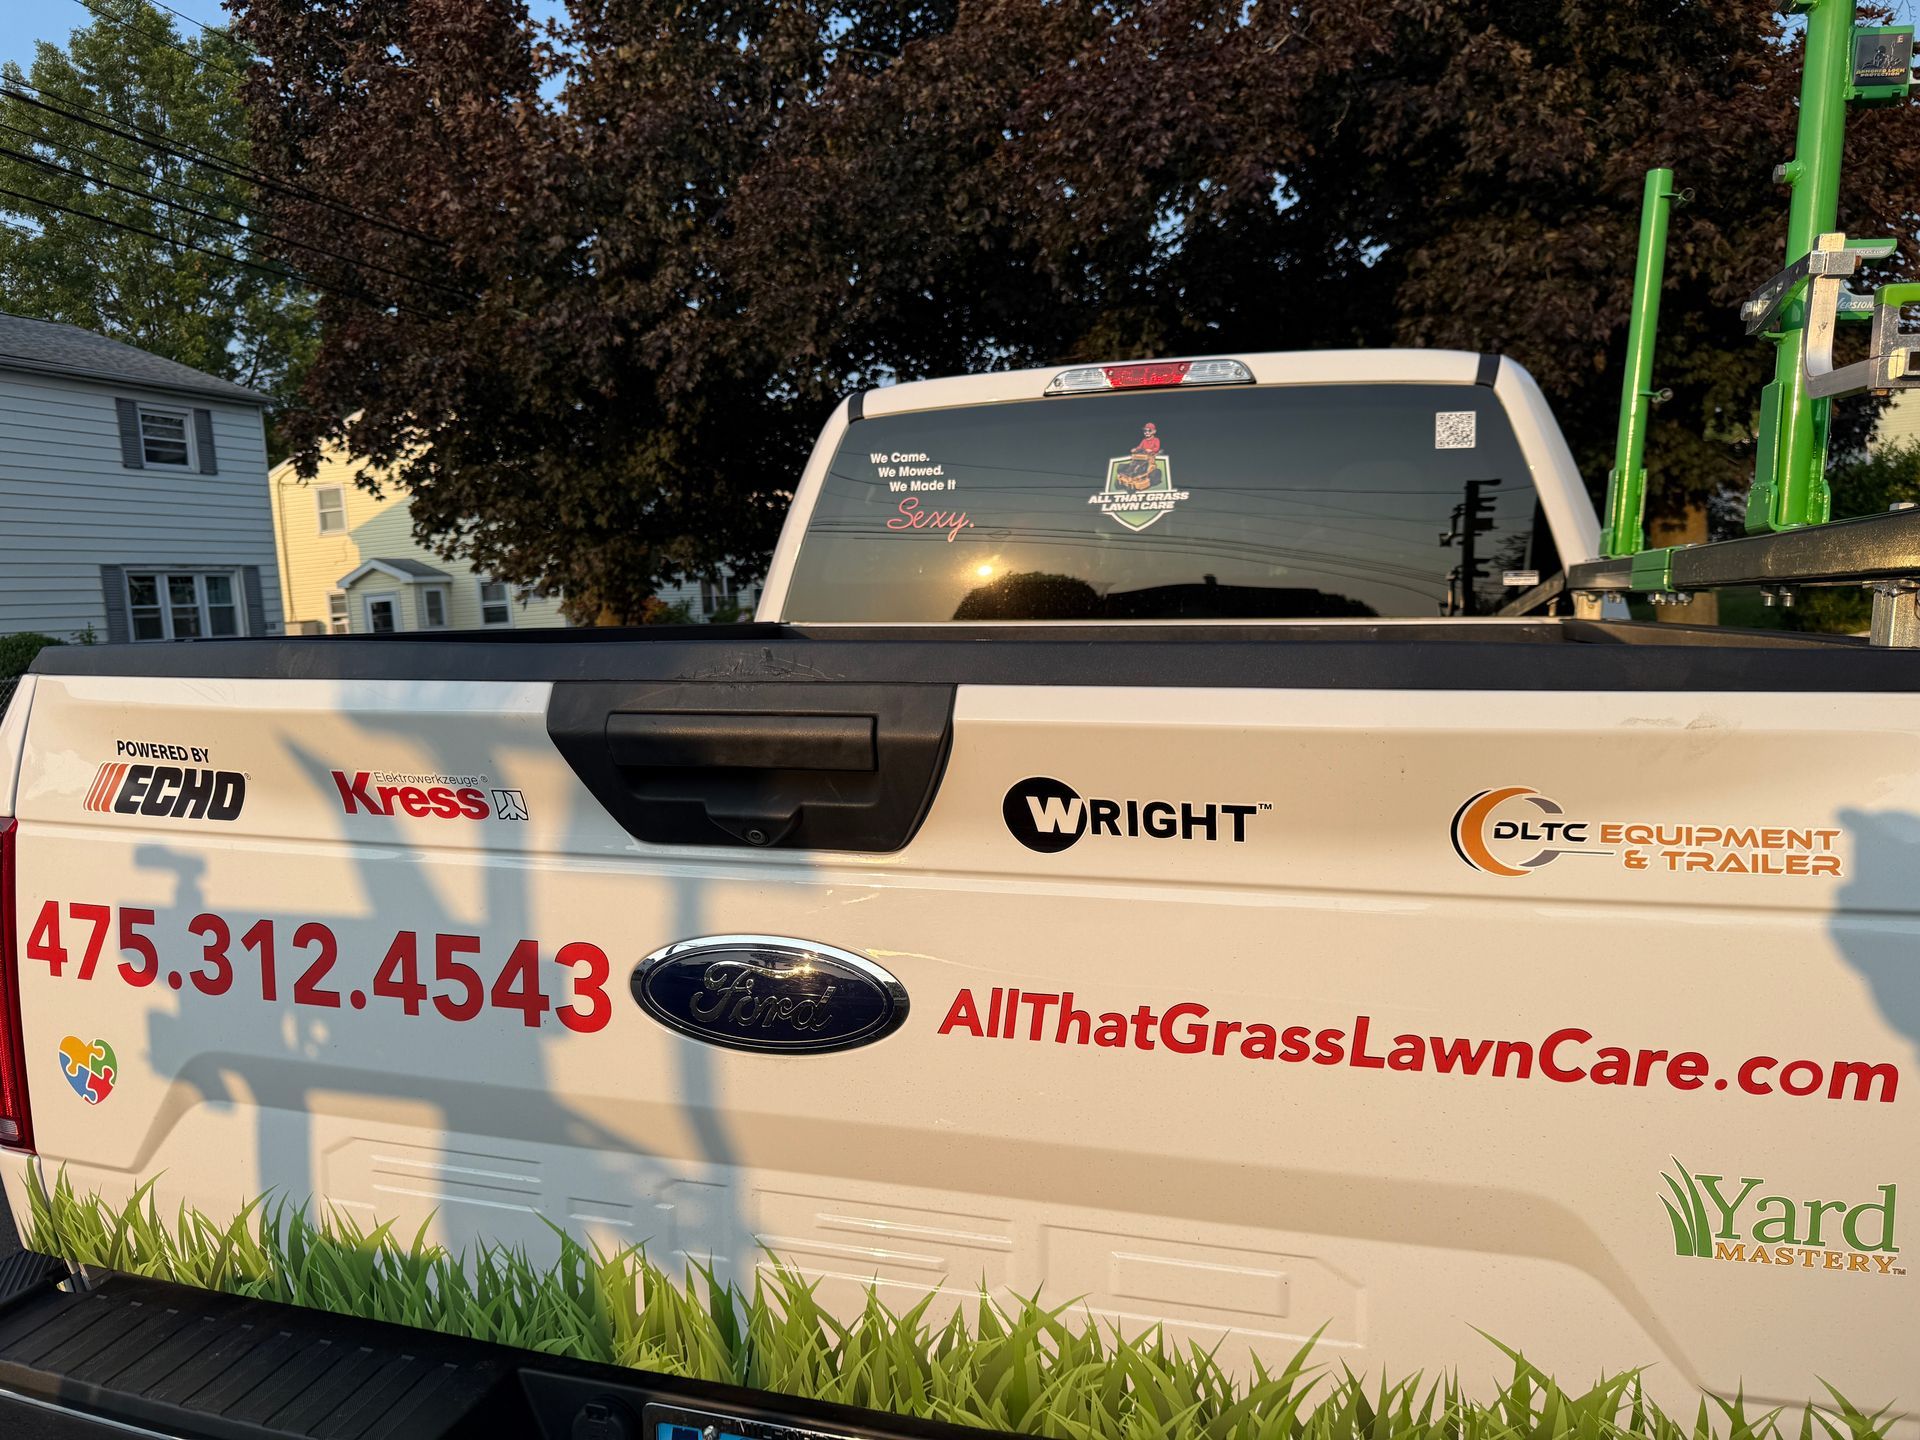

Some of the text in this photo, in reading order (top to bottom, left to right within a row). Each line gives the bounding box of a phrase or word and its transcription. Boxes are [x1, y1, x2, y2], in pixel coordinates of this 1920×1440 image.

[870, 452, 930, 464] We Came.
[878, 465, 944, 478] We Mowed.
[889, 479, 956, 492] We Made It
[1088, 491, 1190, 504] ALL THAT GRASS
[887, 497, 974, 543] Sexy.
[1101, 501, 1176, 512] LAWN CARE
[116, 740, 209, 763] POWERED BY
[114, 764, 246, 821] ECHO
[331, 770, 490, 820] Kress
[374, 772, 479, 788] Elektrowerkzeuge
[1025, 795, 1257, 843] WRIGHT
[1493, 821, 1841, 850] DLTC EQUIPMENT
[1624, 850, 1843, 877] & TRAILER
[26, 900, 612, 1034] 475.312.4543
[690, 960, 836, 1032] Ford
[938, 988, 1900, 1104] AllThatGrassLawnCare.com
[1694, 1174, 1900, 1253] Yard
[1714, 1242, 1897, 1274] MASTERY
